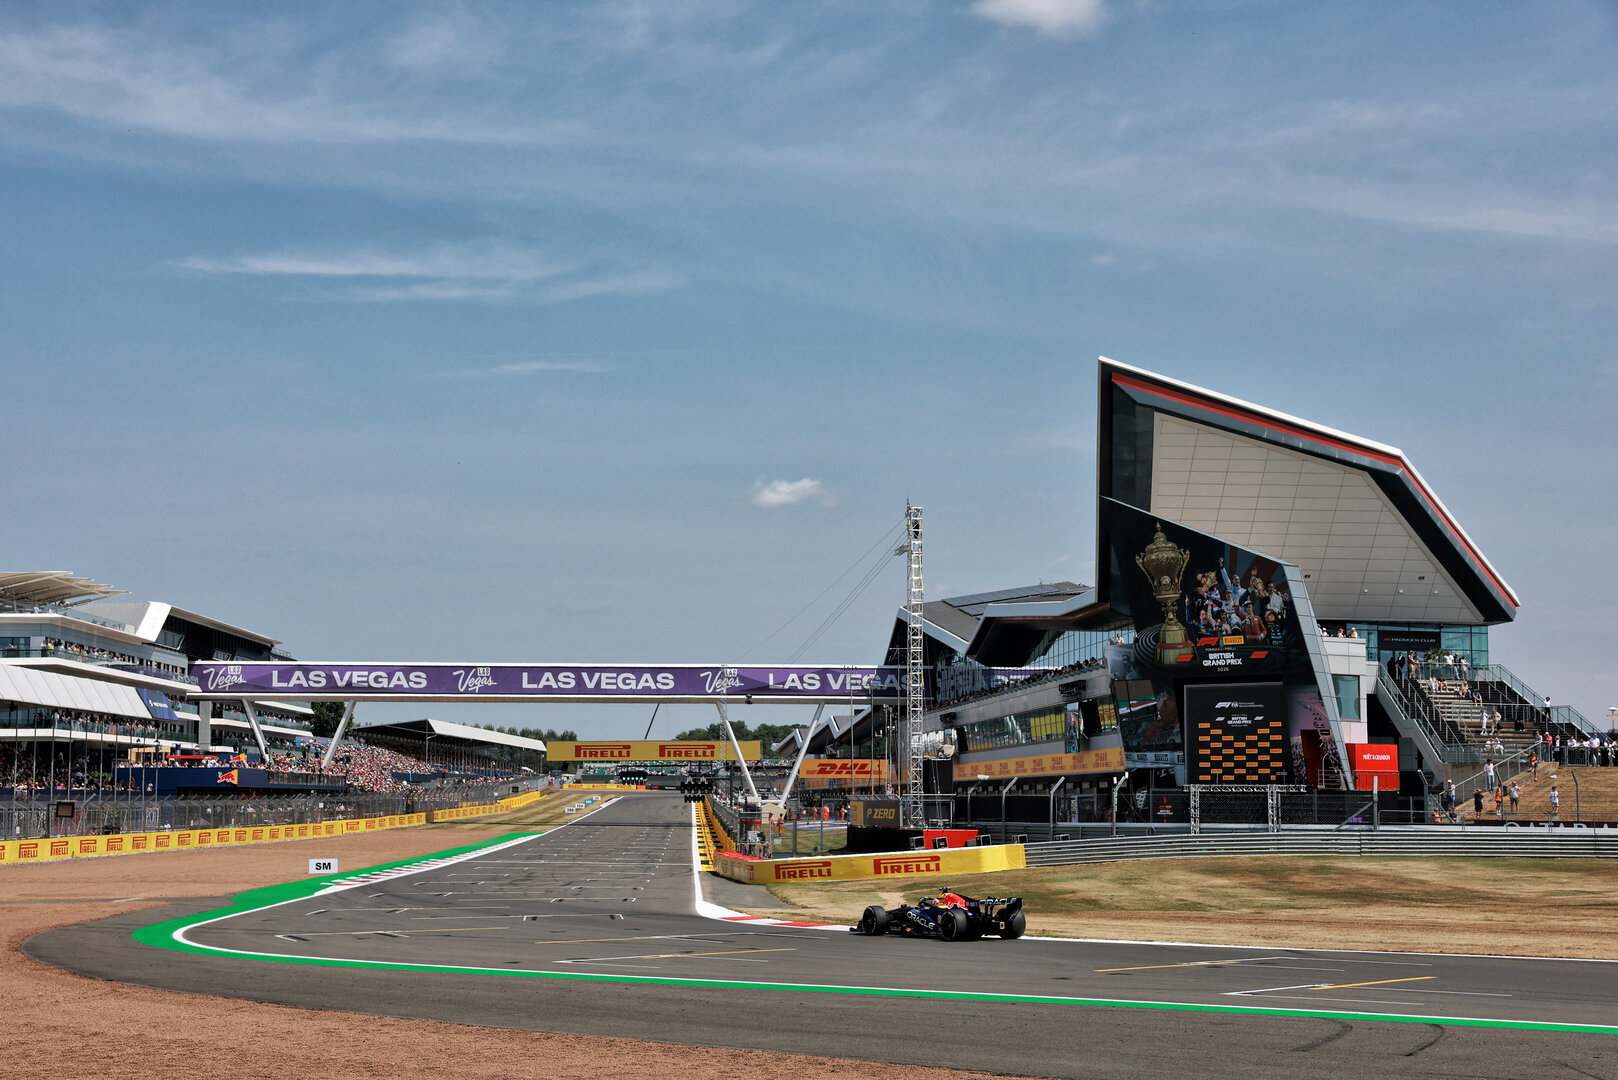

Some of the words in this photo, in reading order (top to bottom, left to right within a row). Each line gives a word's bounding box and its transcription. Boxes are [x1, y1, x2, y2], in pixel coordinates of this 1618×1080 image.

[228, 666, 241, 674] LAS
[477, 667, 490, 676] LAS
[203, 668, 246, 690] Vegas
[272, 670, 326, 688] LAS
[332, 671, 428, 688] VEGAS
[452, 669, 497, 693] Vegas
[522, 672, 576, 689] LAS
[581, 672, 674, 689] VEGAS
[700, 671, 744, 694] Vegas
[769, 673, 821, 689] LAS
[826, 674, 918, 690] VEGAS
[575, 745, 631, 758] PIRELLI
[659, 744, 715, 757] PIRELLI
[816, 763, 873, 774] DHL
[867, 808, 872, 819] P
[873, 808, 895, 819] ZERO
[50, 841, 69, 856] PIRELLI
[80, 839, 97, 854] PIRELLI
[107, 838, 123, 852] PIRELLI
[132, 836, 147, 849] PIRELLI
[156, 835, 170, 848] PIRELLI
[19, 843, 38, 858] PIRELLI
[774, 861, 831, 879] PIRELLI
[873, 856, 940, 875] PIRELLI
[979, 898, 1016, 906] ORACLE
[906, 911, 935, 930] ORACLE
